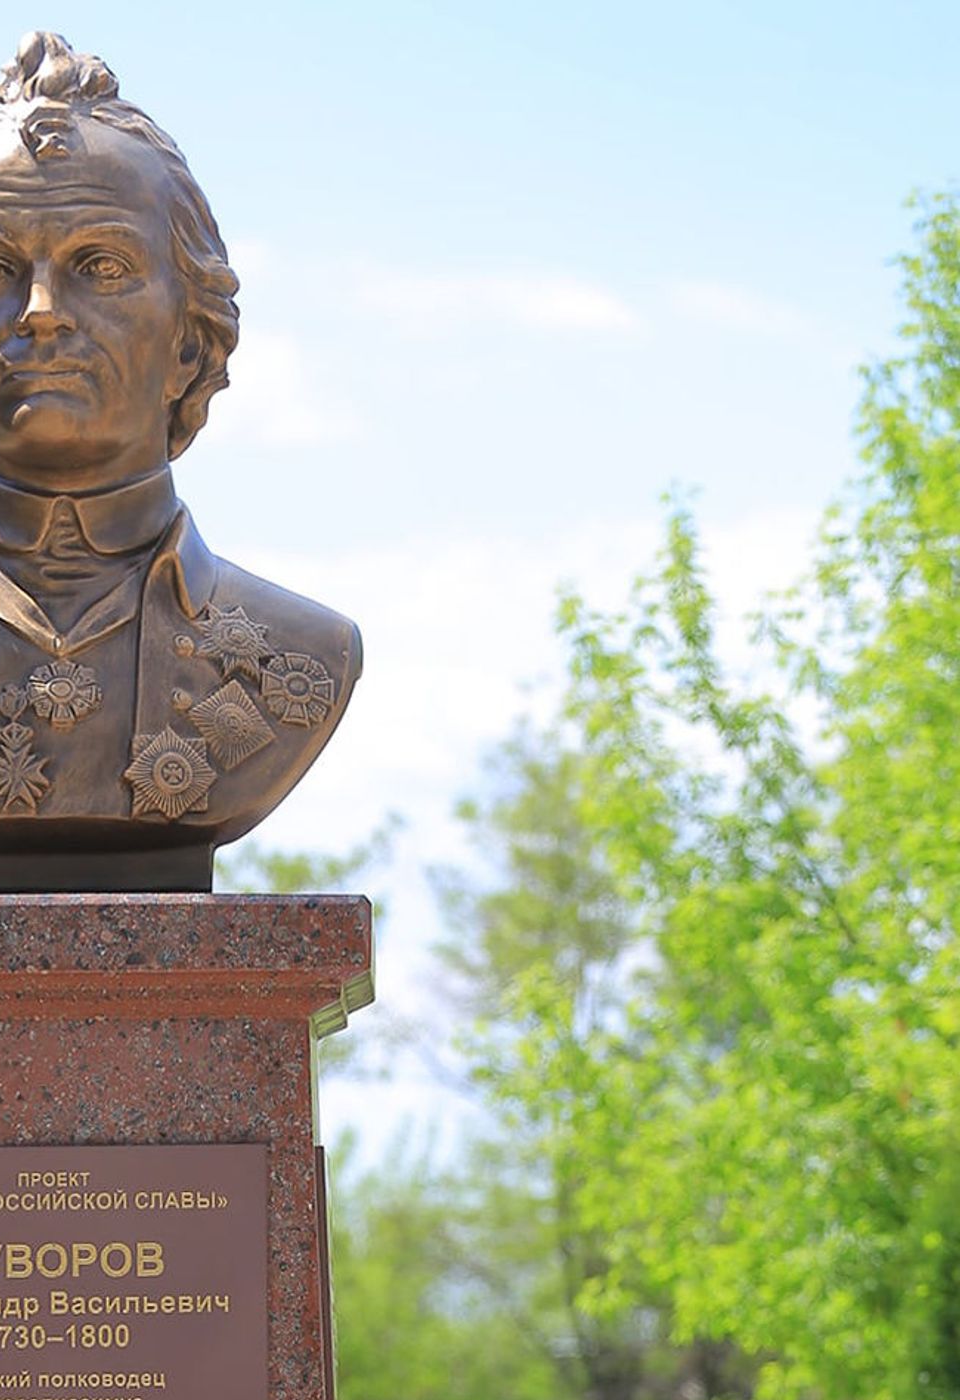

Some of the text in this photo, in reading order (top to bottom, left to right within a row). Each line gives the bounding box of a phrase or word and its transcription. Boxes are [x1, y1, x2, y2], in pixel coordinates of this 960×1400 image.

[19, 1172, 90, 1187] ПРОЕКТ
[135, 1192, 228, 1209] СЛАВЫ»
[51, 1292, 229, 1315] Васильевич
[39, 1373, 166, 1388] полководец
